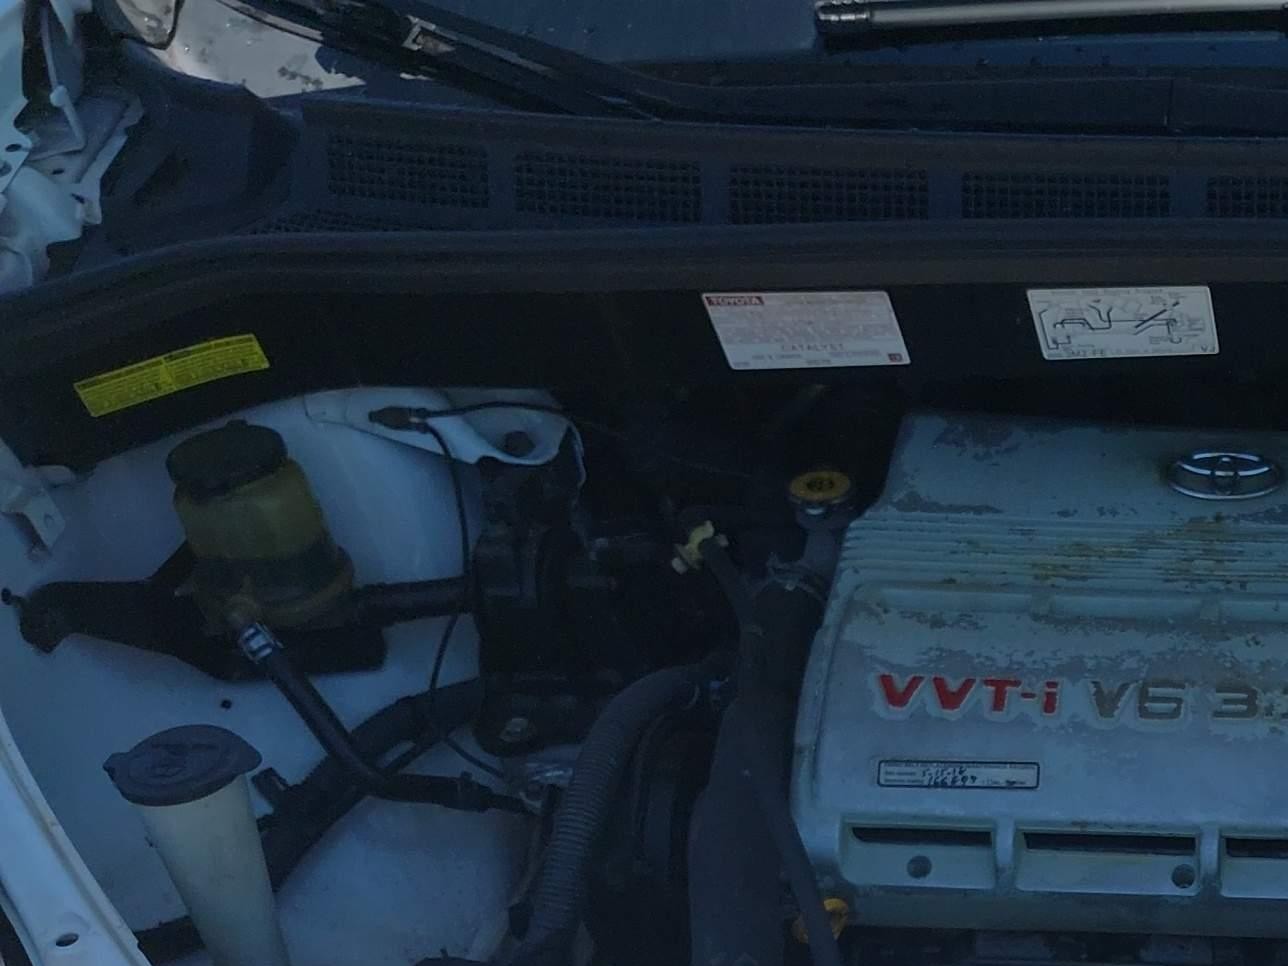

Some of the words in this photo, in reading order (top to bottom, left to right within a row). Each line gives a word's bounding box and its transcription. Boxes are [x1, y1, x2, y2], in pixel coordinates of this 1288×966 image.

[707, 296, 761, 306] TOYOTA
[878, 673, 1059, 714] VVT-i
[1089, 677, 1187, 720] V6
